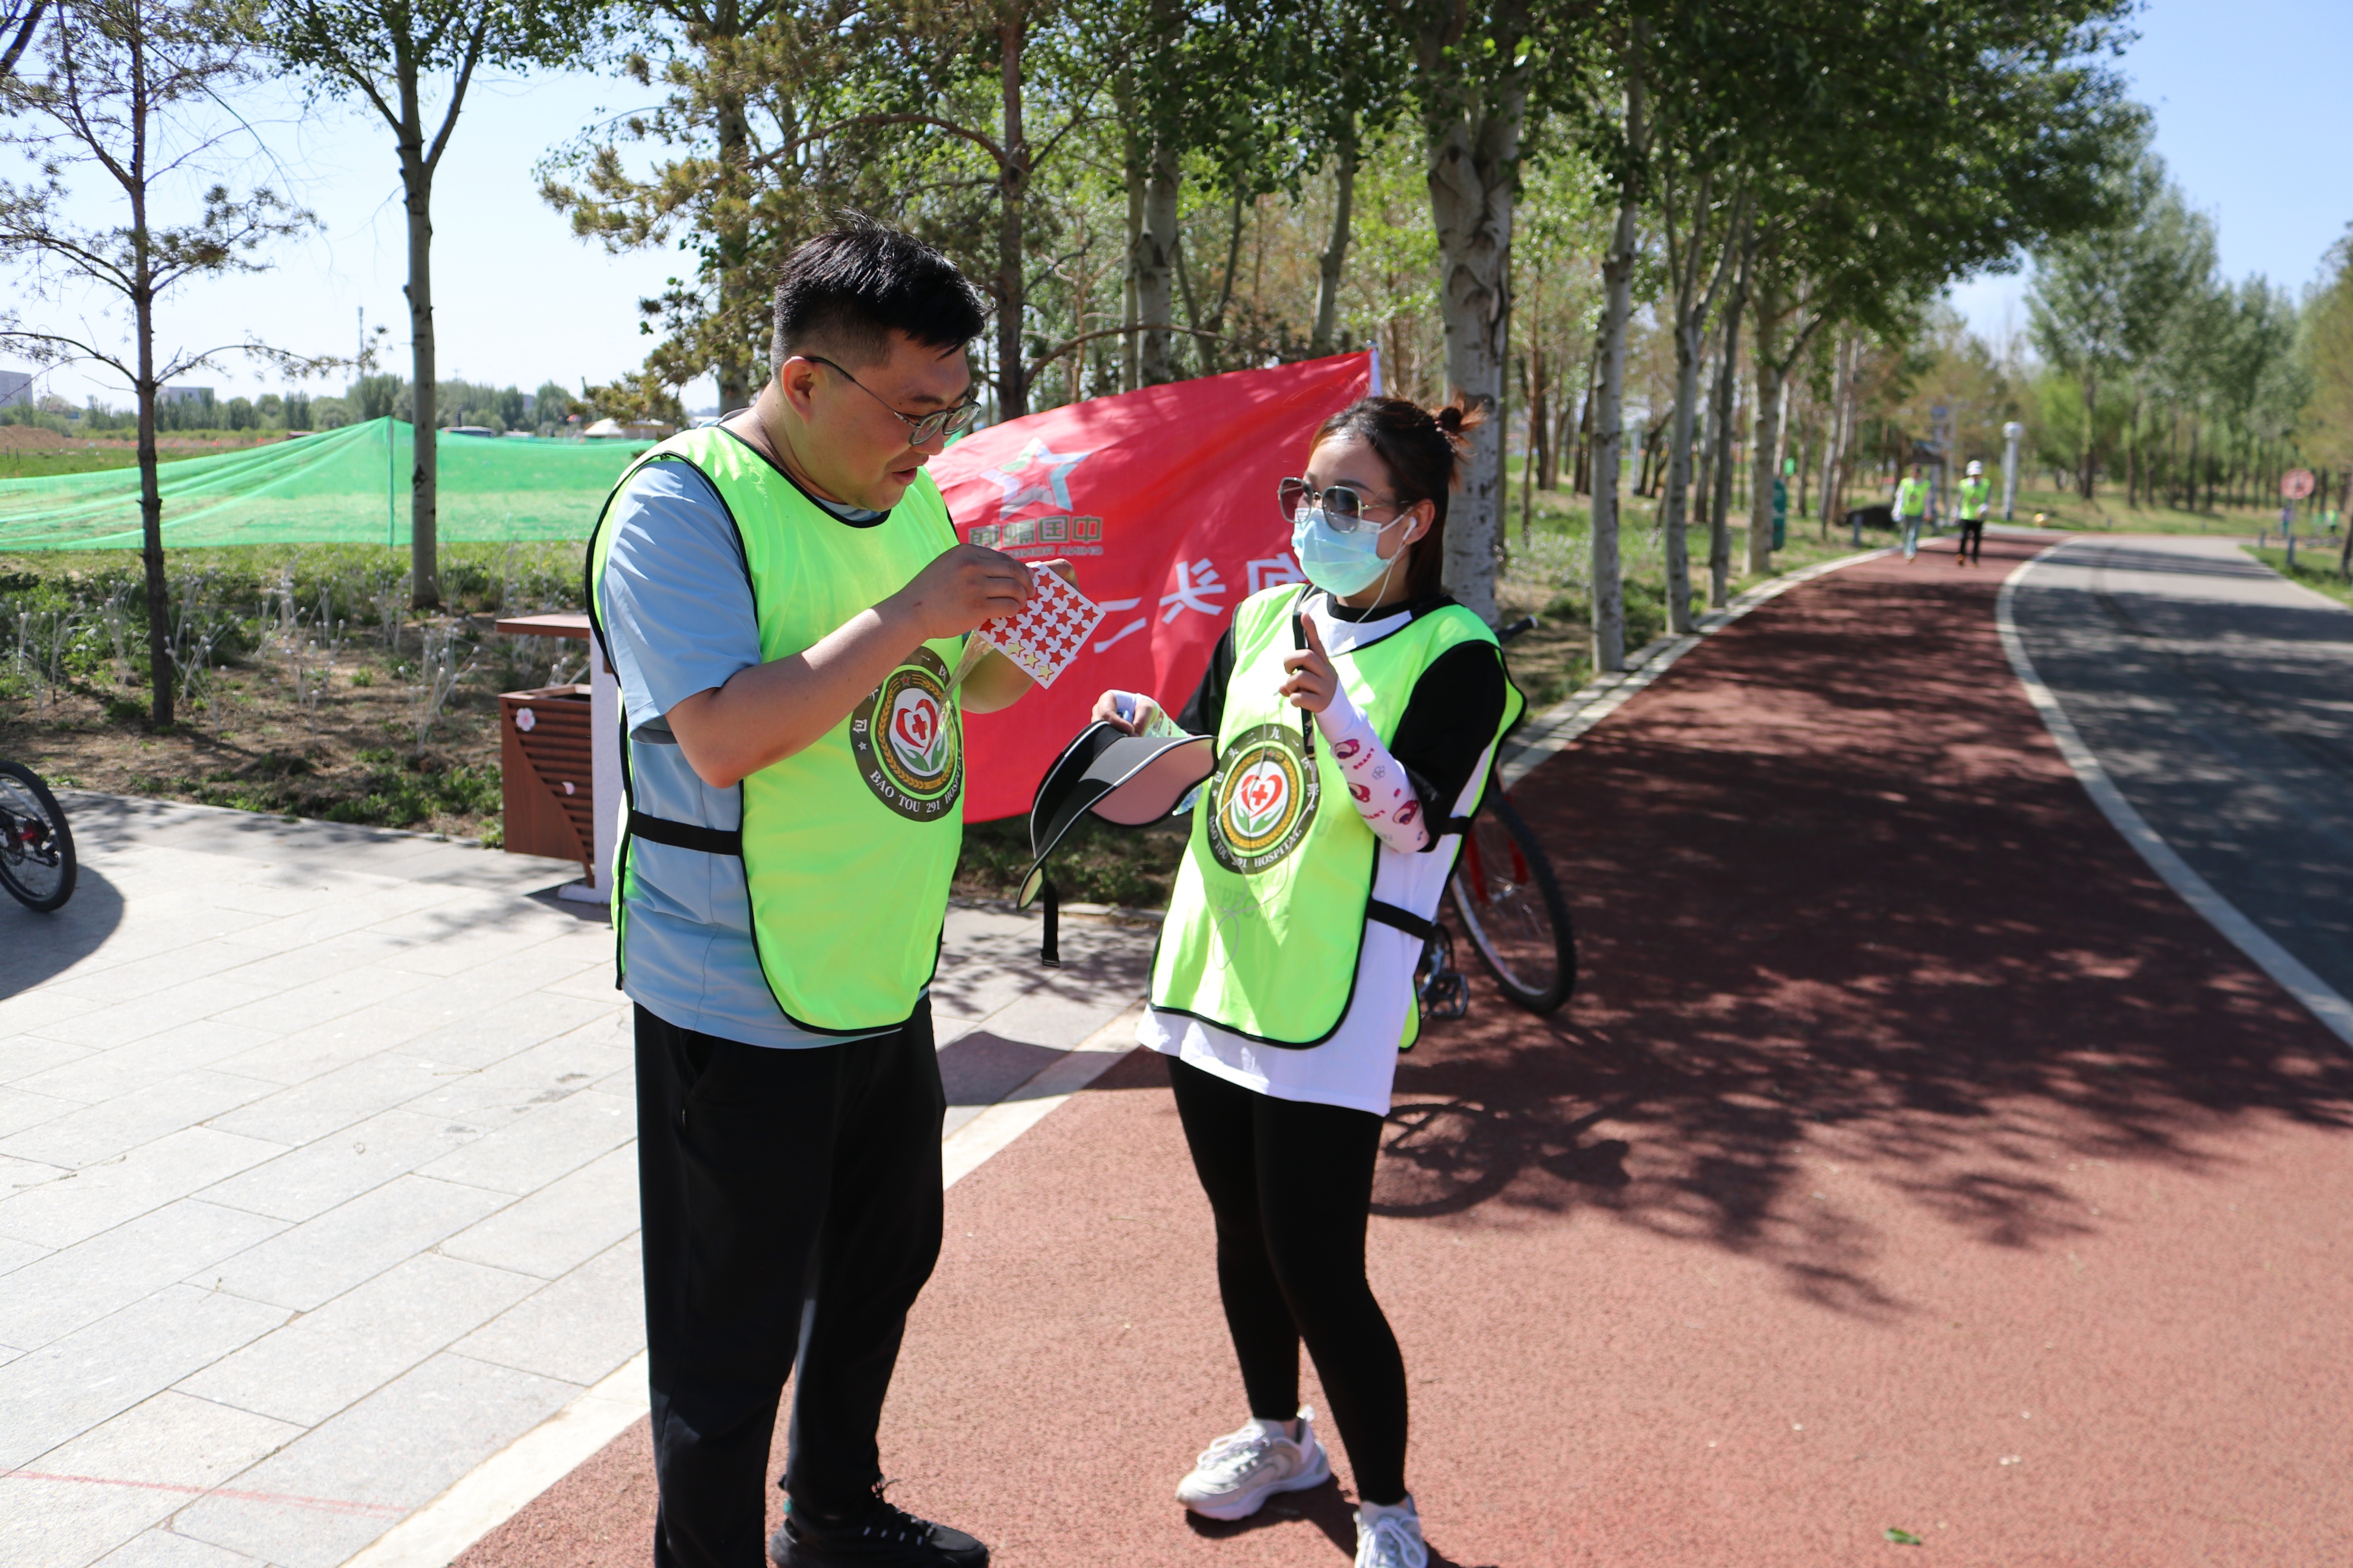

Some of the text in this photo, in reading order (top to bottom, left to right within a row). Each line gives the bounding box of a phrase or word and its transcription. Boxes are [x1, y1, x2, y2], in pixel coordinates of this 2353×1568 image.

[869, 769, 894, 797] BAO
[898, 794, 920, 813] TOU
[926, 800, 940, 813] 291
[1254, 829, 1302, 867] HOSPITAL
